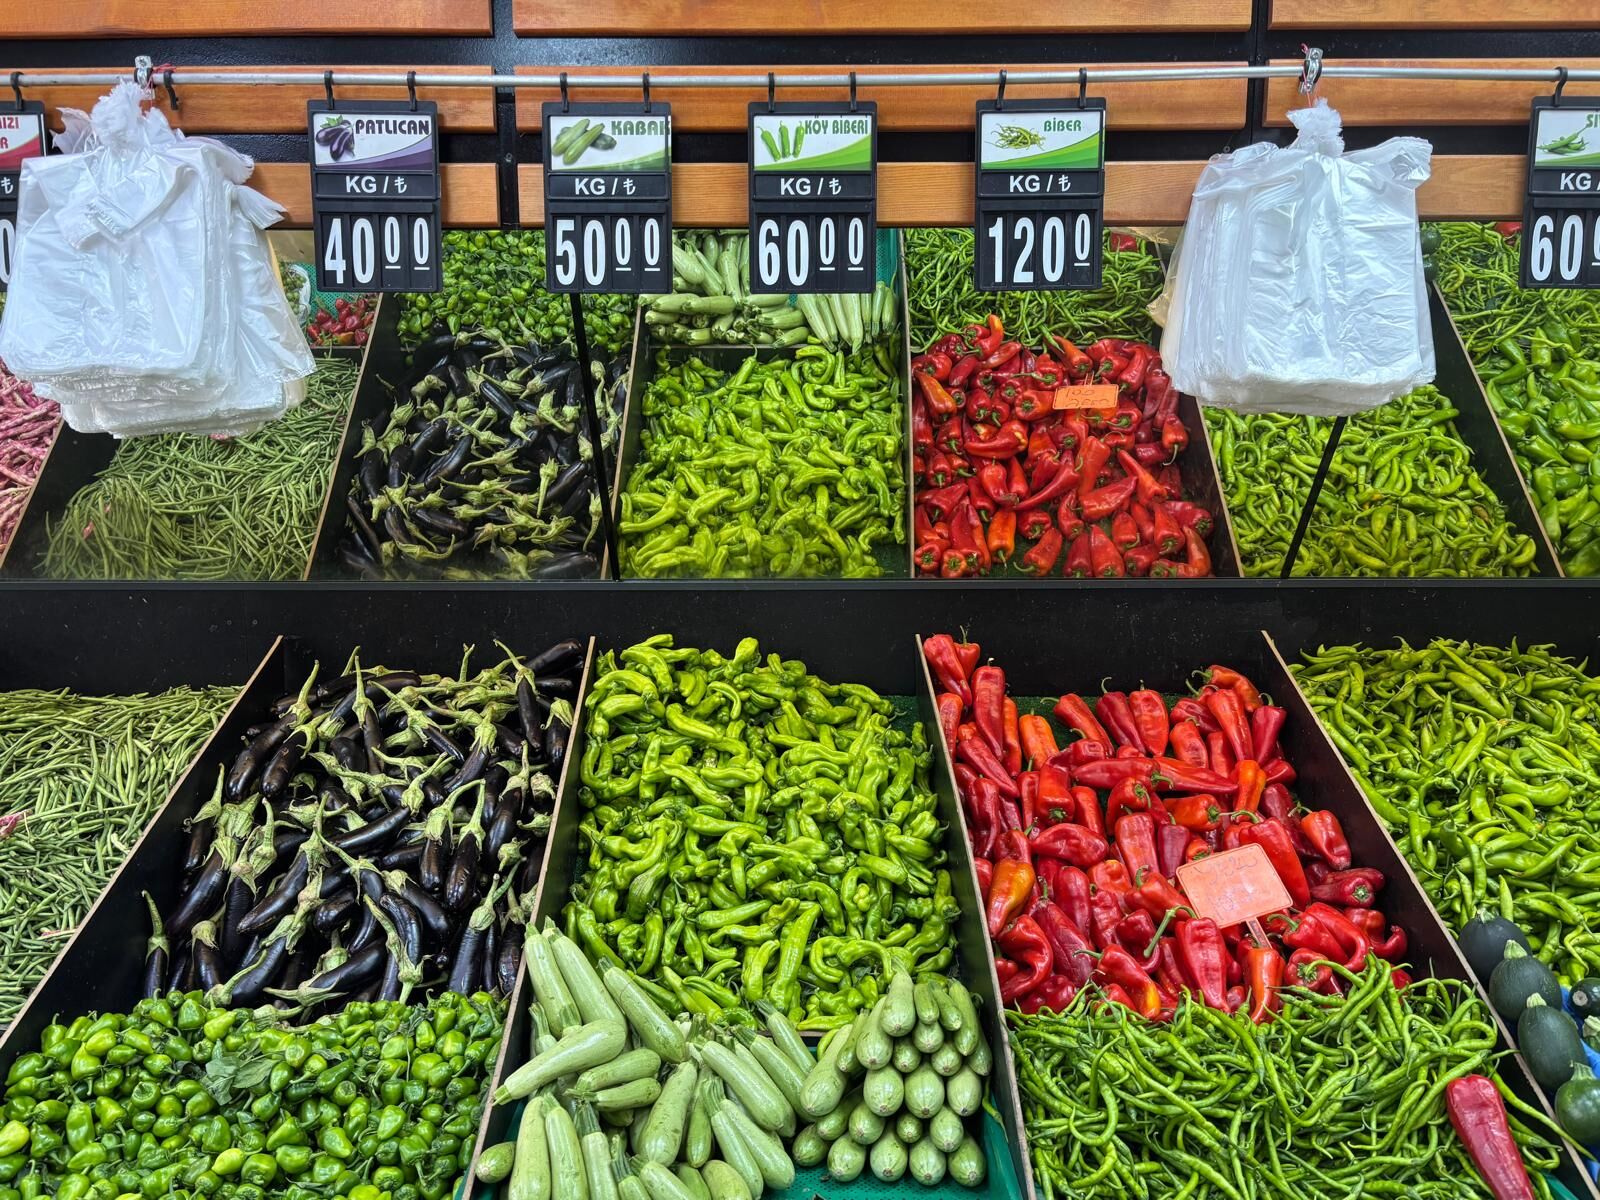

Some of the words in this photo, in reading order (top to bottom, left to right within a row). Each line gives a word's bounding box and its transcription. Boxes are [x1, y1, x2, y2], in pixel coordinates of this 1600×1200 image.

[355, 119, 430, 135] PATLICAN
[805, 115, 829, 135] KÖY
[1043, 117, 1082, 132] BİBER
[345, 175, 377, 194] KG
[575, 177, 606, 196] KG
[780, 177, 812, 196] KG
[1009, 175, 1041, 193] KG
[1560, 172, 1592, 191] KG
